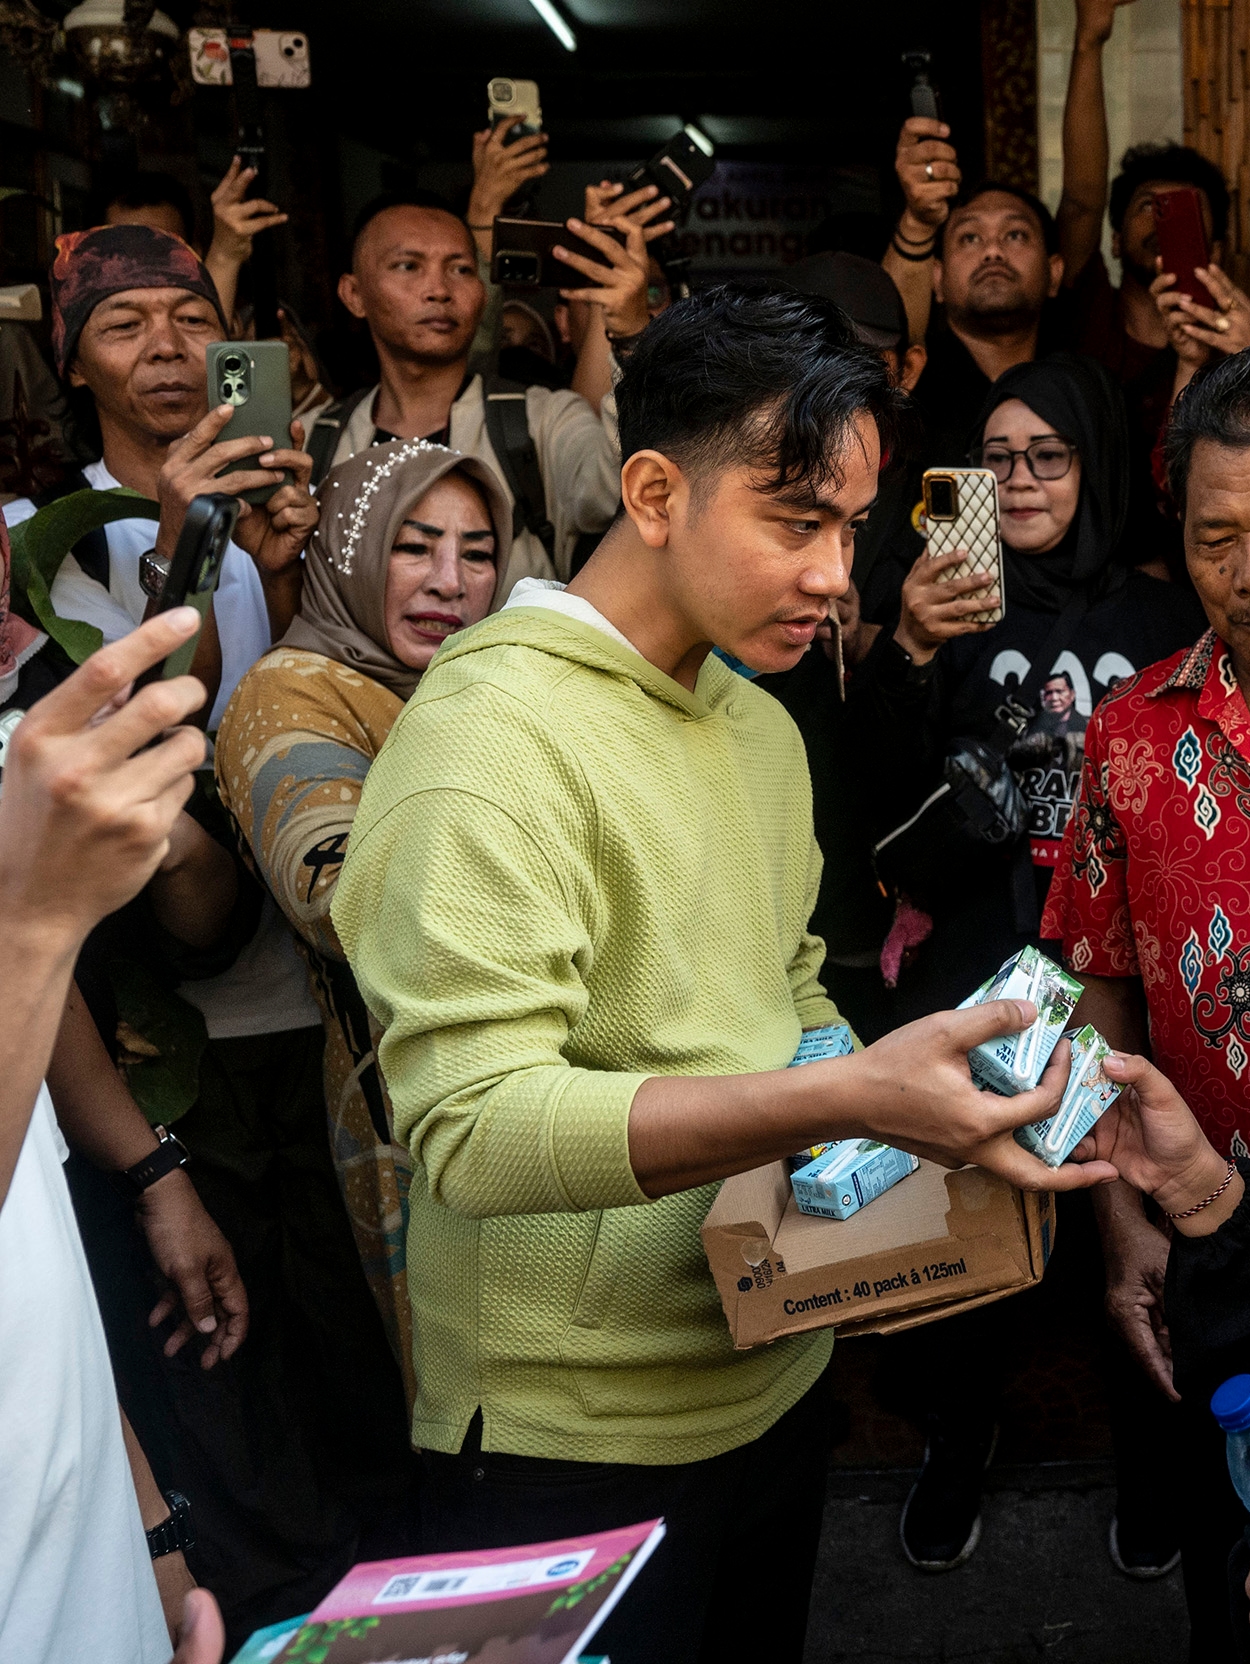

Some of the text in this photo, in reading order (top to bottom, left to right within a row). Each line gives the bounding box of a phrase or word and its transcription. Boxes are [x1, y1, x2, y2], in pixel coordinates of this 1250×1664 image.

[750, 1264, 766, 1289] 0900
[783, 1288, 843, 1315] Content
[853, 1280, 871, 1299] 40
[873, 1272, 909, 1297] pack
[922, 1258, 968, 1282] 125ml
